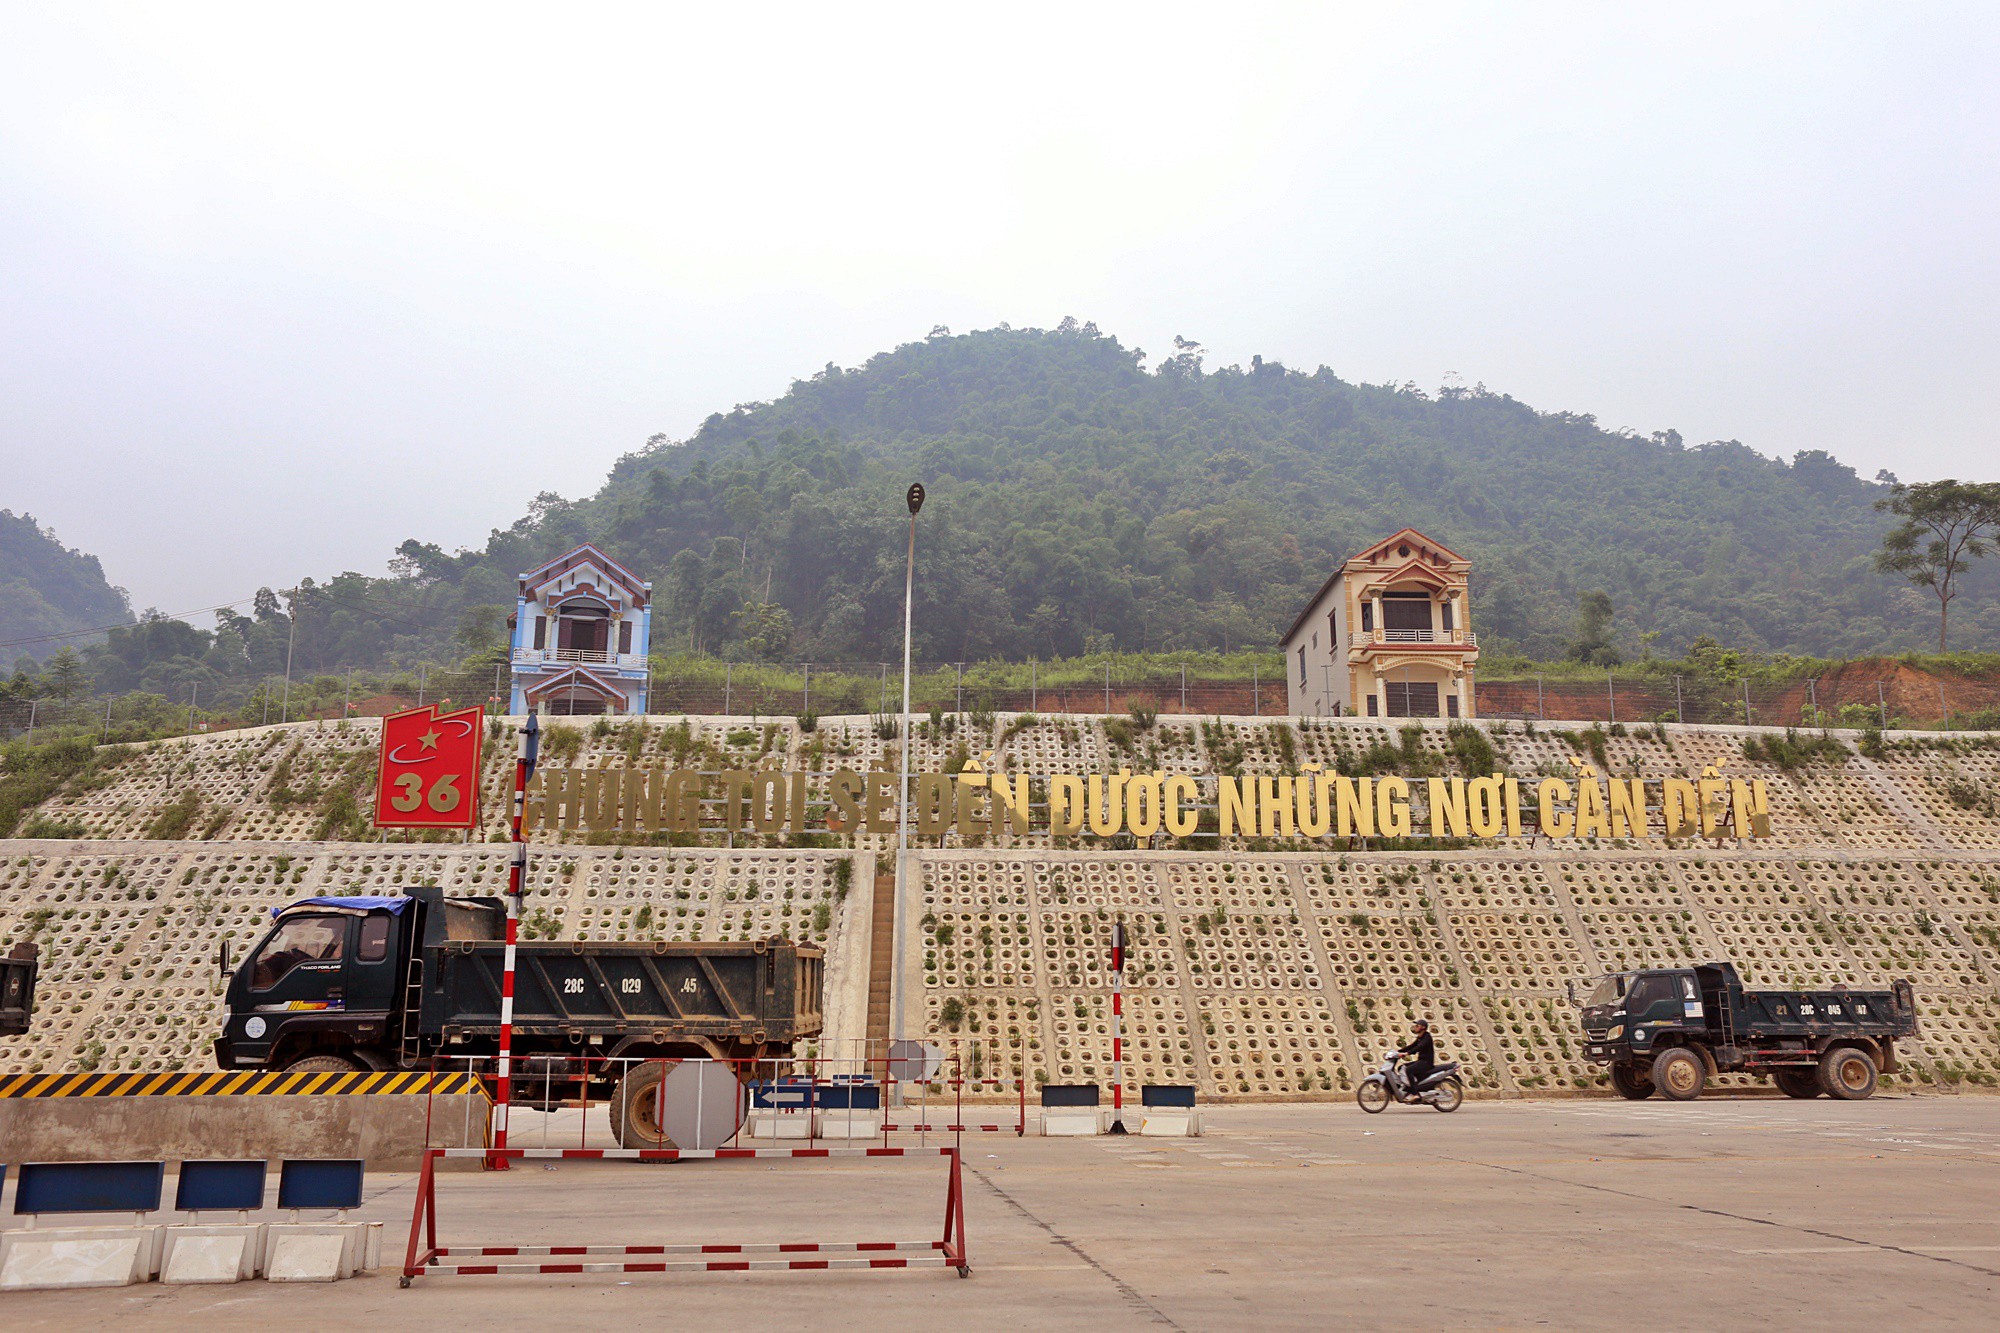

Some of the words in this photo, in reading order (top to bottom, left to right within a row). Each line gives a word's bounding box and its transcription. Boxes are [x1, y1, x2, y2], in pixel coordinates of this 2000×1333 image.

[391, 772, 460, 812] 36
[506, 756, 700, 832] CHÚNG
[721, 758, 806, 833] TÔI
[915, 750, 1029, 835] ĐẾN
[1049, 768, 1198, 848] ĐƯỢC
[1218, 763, 1412, 837] NHỮNG
[1428, 773, 1522, 837] NƠI
[1538, 757, 1648, 838] CẦN
[1662, 758, 1771, 838] ĐẾN
[564, 978, 584, 993] 28C
[622, 978, 641, 993] 029
[1800, 1004, 1814, 1015] 28C
[1828, 1004, 1841, 1015] 045
